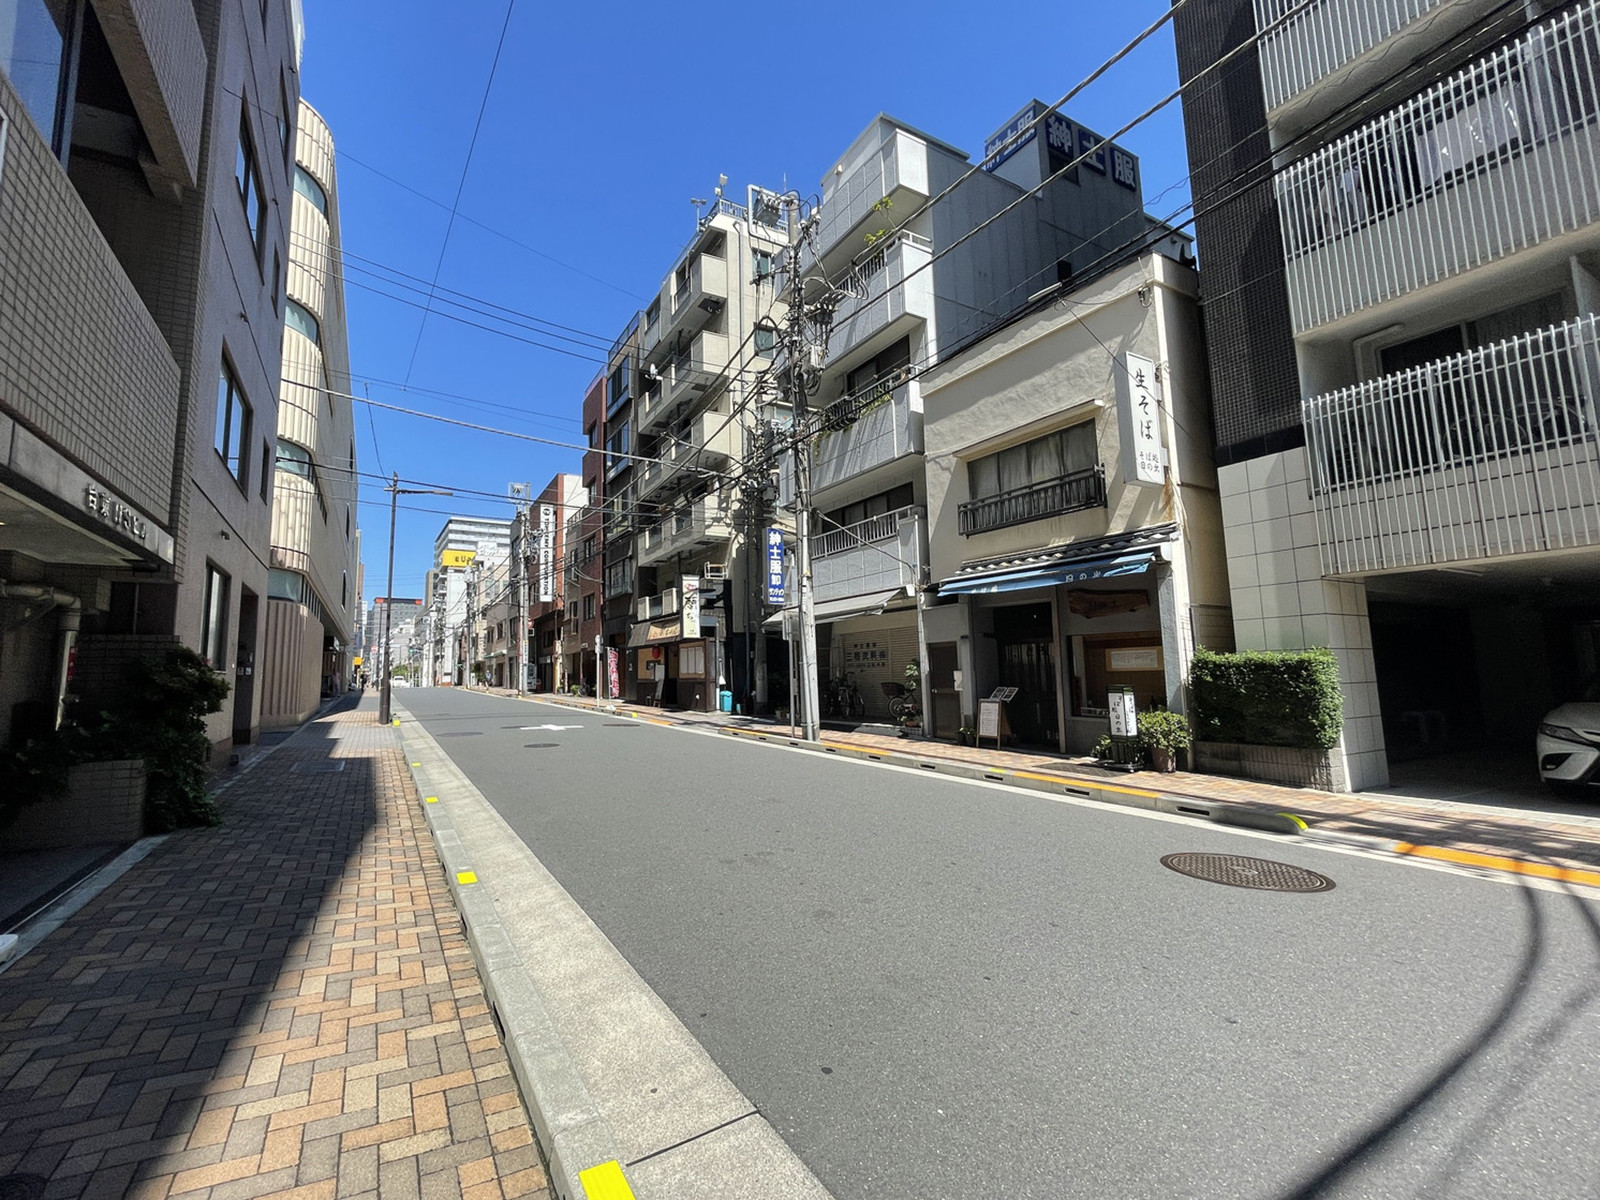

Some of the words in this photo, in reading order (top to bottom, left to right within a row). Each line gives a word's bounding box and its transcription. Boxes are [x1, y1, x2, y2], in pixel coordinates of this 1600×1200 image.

[985, 110, 1036, 169] 紳士服
[1046, 114, 1136, 188] 紳士服
[1134, 367, 1153, 441] 生そば
[768, 531, 783, 586] 紳士服卸
